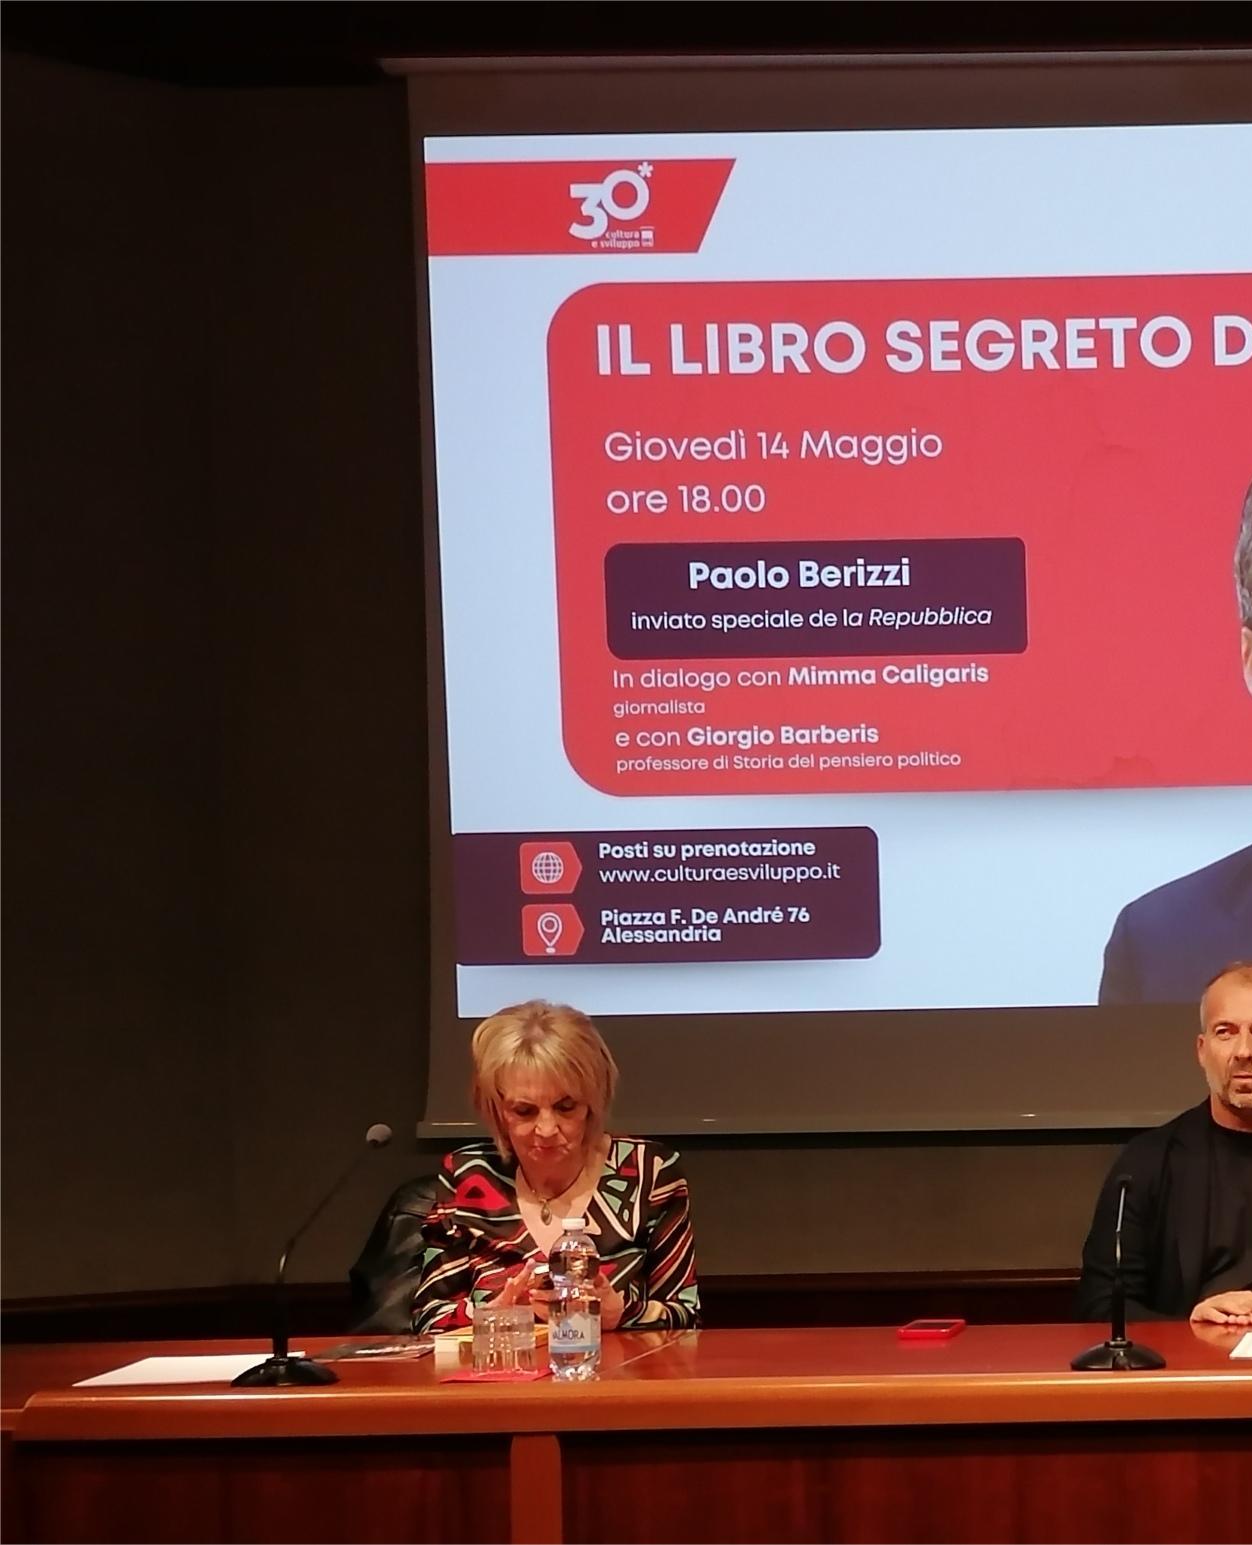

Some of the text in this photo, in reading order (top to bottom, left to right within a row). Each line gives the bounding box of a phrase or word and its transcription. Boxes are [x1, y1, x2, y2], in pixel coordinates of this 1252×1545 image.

[597, 324, 651, 375] IL
[670, 320, 866, 375] LIBRO
[885, 315, 1192, 373] SEGRETO
[604, 427, 943, 466] Giovedì 14 Maggio
[606, 484, 766, 514] ore 18.00
[689, 557, 910, 590] Paolo Berizzi
[631, 606, 992, 633] inviato speciale de la Repubblica
[613, 662, 989, 692] In dialogo con Mimma Caligaris
[613, 699, 706, 719] giornalista
[615, 723, 879, 750] e con Giorgio Barberis
[616, 751, 962, 774] professore di Storia del pensiero politico
[598, 838, 816, 862] Posti su prenotazione
[598, 862, 841, 883] www.culturaesviluppo.it
[601, 906, 810, 926] Piazza F. De André 76
[601, 924, 722, 944] Alessandria
[552, 1328, 585, 1341] ALMORA
